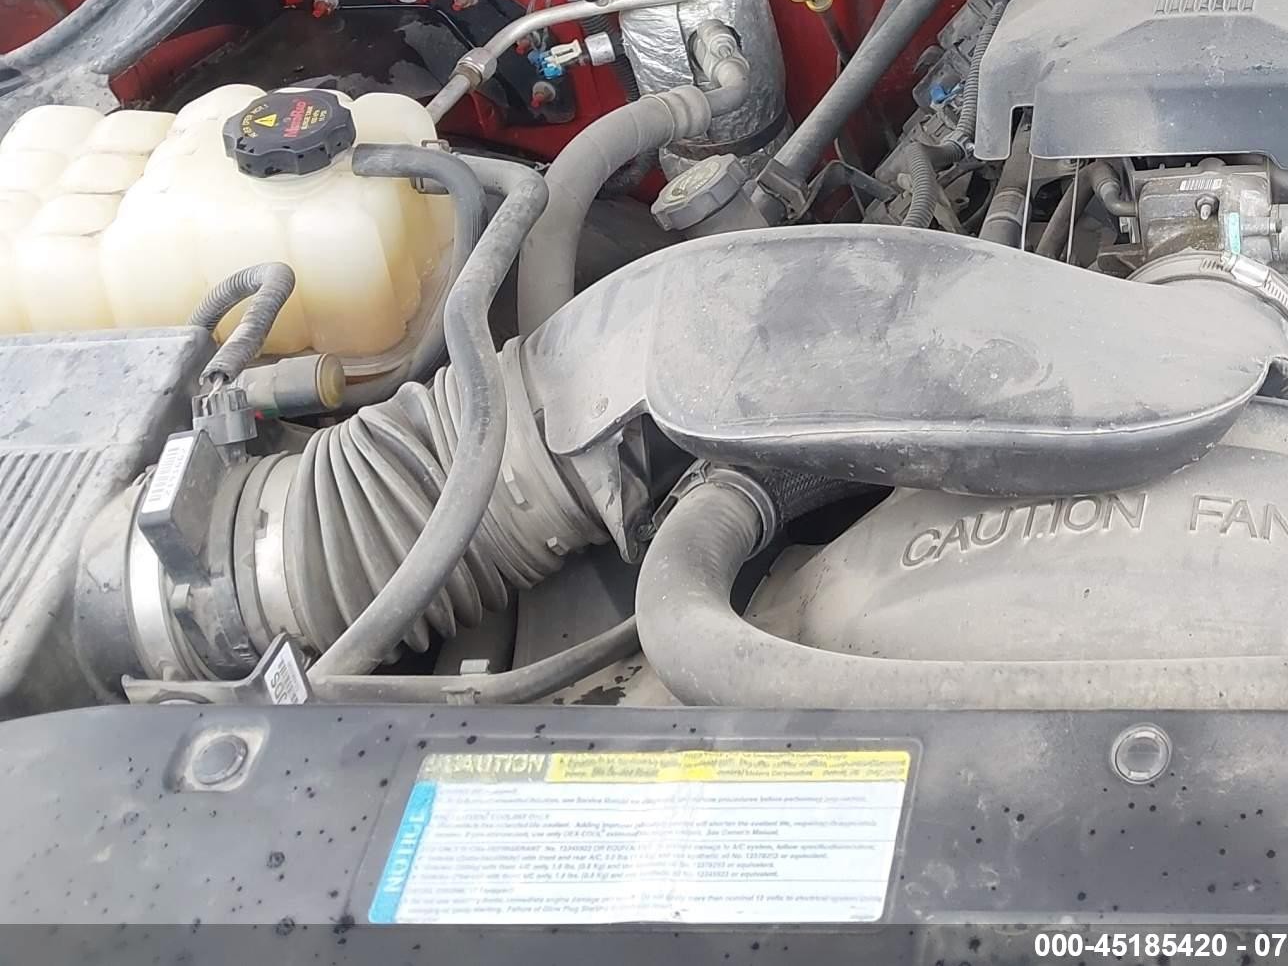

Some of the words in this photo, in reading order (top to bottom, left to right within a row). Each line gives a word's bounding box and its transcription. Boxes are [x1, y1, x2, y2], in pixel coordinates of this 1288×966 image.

[901, 492, 1148, 569] CAUTION
[449, 753, 545, 773] CAUTION
[383, 812, 425, 895] NOTICE
